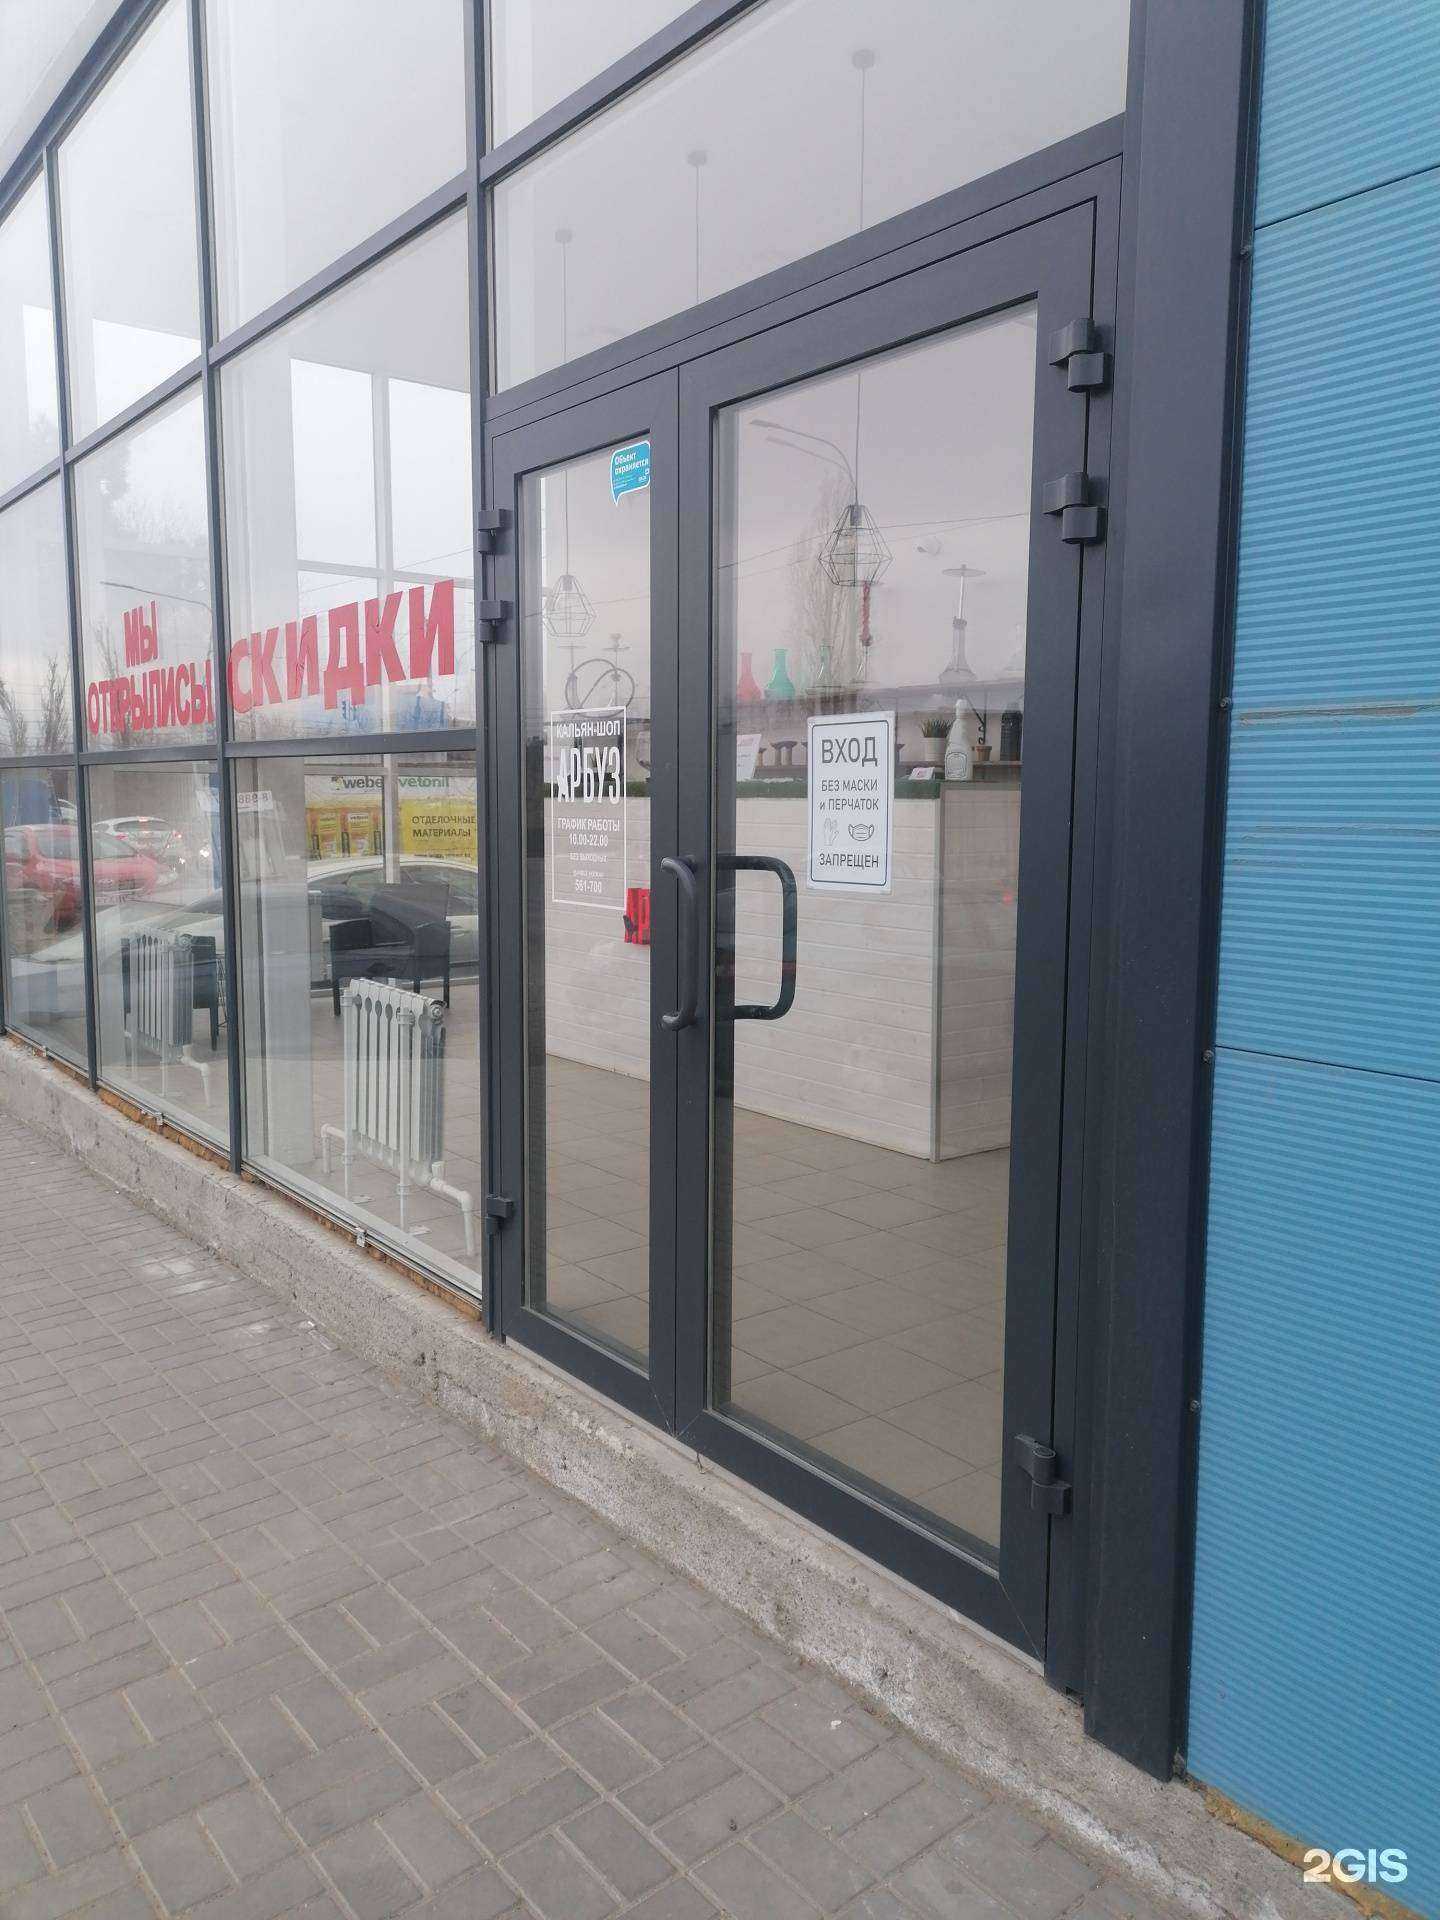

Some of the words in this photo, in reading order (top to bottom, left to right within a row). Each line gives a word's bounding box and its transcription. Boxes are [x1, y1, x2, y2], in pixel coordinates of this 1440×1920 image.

[123, 600, 159, 669] МЫ
[227, 579, 455, 715] СКИДКИ
[556, 719, 621, 738] КАЛЬЯН-ШОП
[821, 736, 878, 767] ВХОД
[343, 775, 384, 789] webe
[556, 746, 621, 805] АРБУЗ
[821, 779, 840, 792] БЕЗ
[842, 779, 878, 792] МАСКИ
[828, 798, 879, 811] ПЕРЧАТОК
[411, 815, 476, 825] ОТДЕЛОЧНЫЕ
[558, 817, 586, 832] ГРАФИК
[587, 818, 621, 833] РАБОТЫ
[412, 827, 471, 838] МАТЕРИАЛЫ
[819, 853, 879, 870] ЗАПРЕЩЕН
